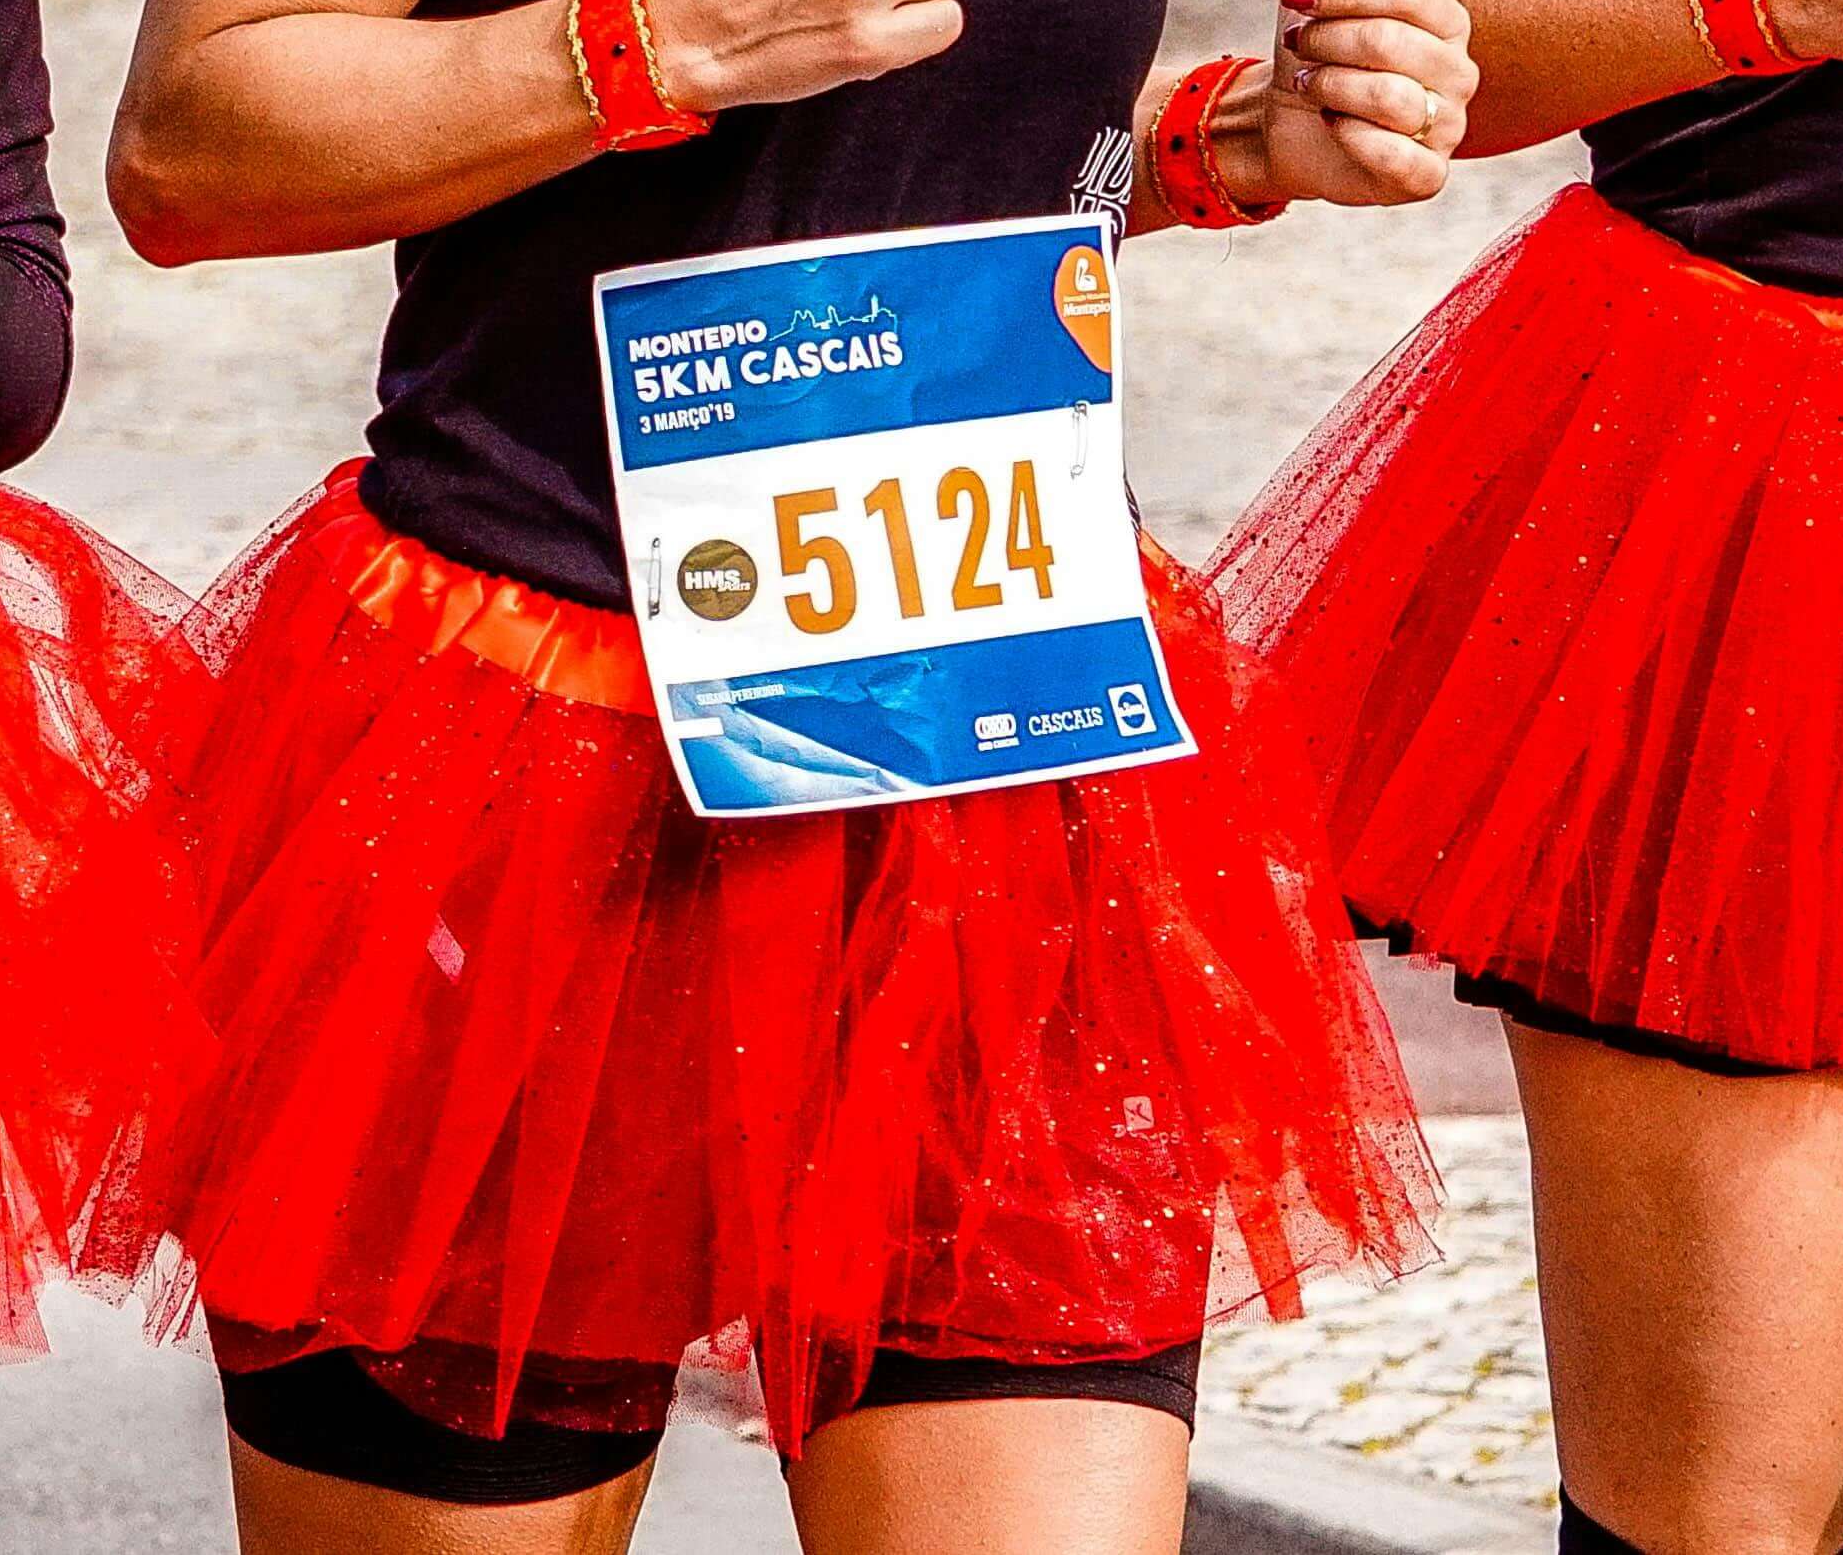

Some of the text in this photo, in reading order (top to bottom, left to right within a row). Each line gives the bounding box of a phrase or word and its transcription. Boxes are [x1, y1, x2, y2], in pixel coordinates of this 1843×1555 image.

[629, 319, 768, 362] MONTEPIO
[634, 331, 903, 403] 5KM CASCAIS
[639, 402, 735, 434] 3 MARÇO'19
[773, 460, 1055, 635] 5124
[685, 569, 741, 590] HMS
[1029, 707, 1104, 736] CASCAIS
